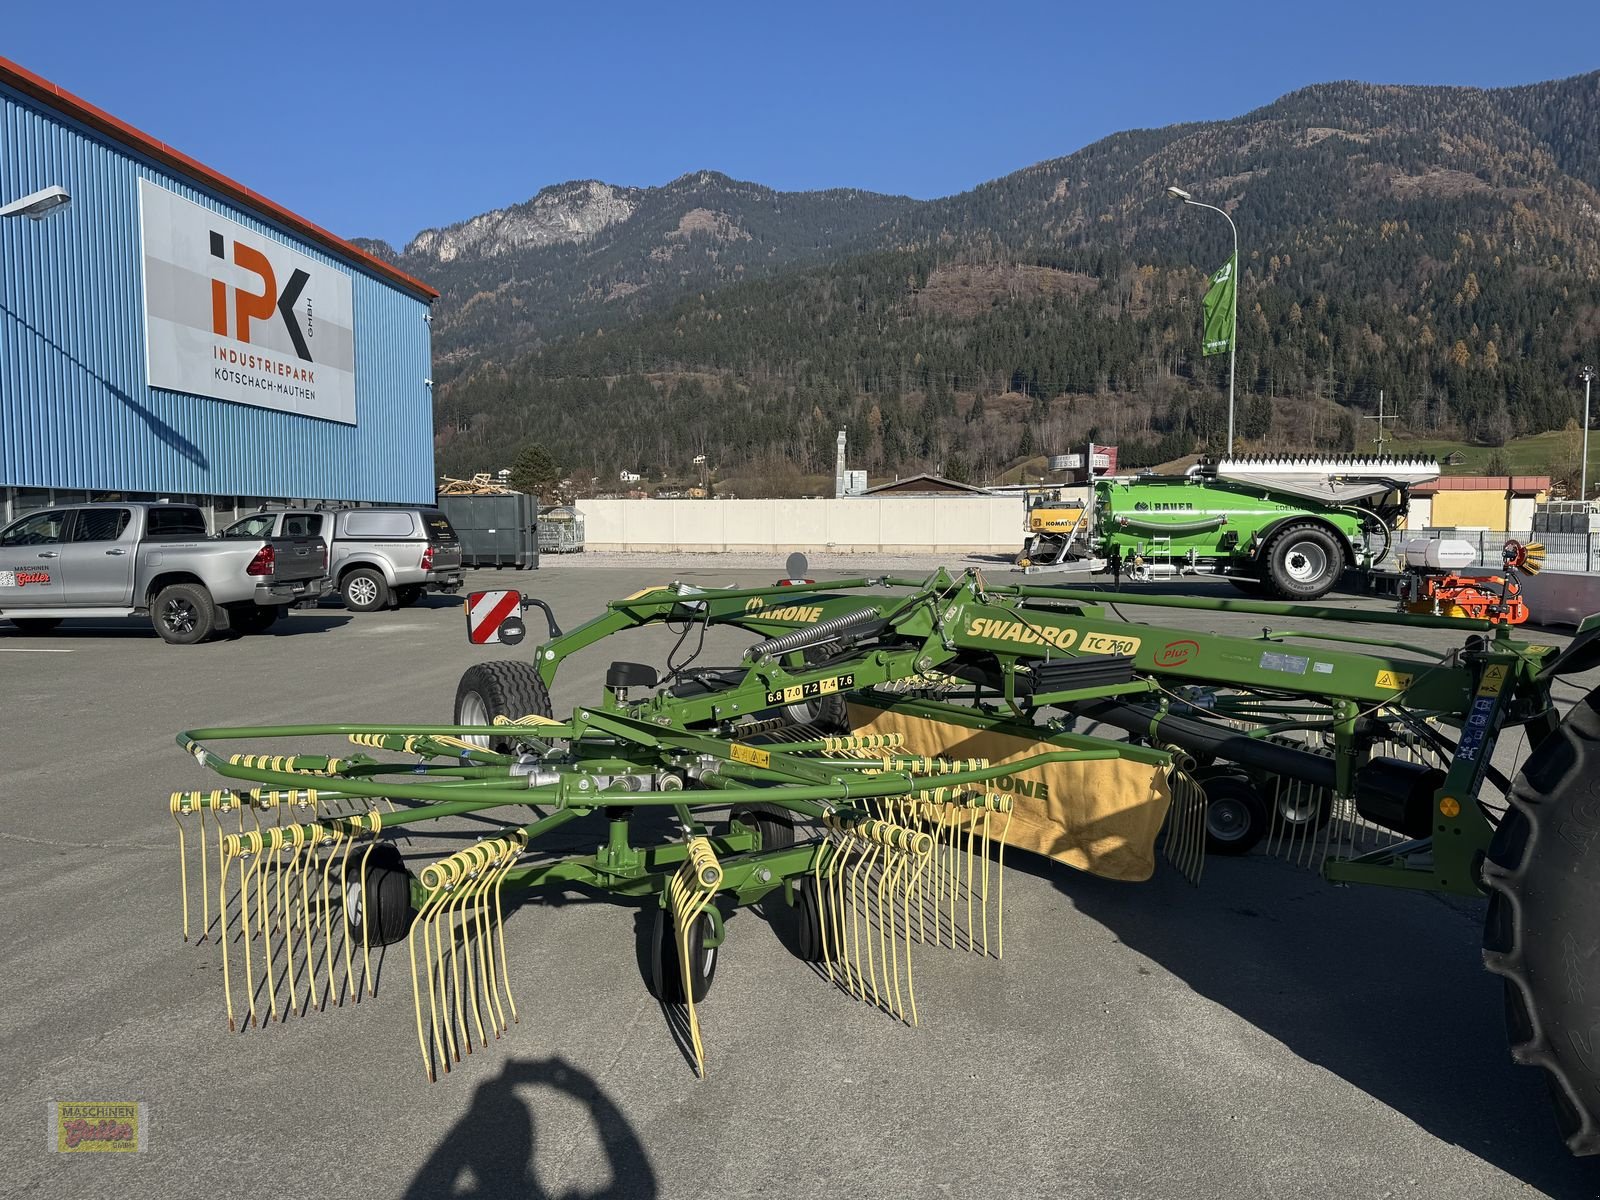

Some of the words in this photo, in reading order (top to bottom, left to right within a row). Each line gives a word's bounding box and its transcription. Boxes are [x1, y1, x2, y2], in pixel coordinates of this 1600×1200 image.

[213, 346, 315, 384] INDUSTRIEPARK
[214, 368, 316, 400] KÖTSCHACH-MAUTHEN
[1154, 502, 1193, 511] BAUER
[16, 572, 50, 586] Gailer
[966, 618, 1078, 649] SWADRO
[1087, 637, 1103, 650] TC
[1107, 638, 1134, 653] 760
[768, 691, 782, 702] 6.8
[787, 687, 801, 698] 7.0
[804, 683, 818, 694] 7.2
[822, 679, 836, 689] 7.4
[839, 675, 853, 686] 7.6
